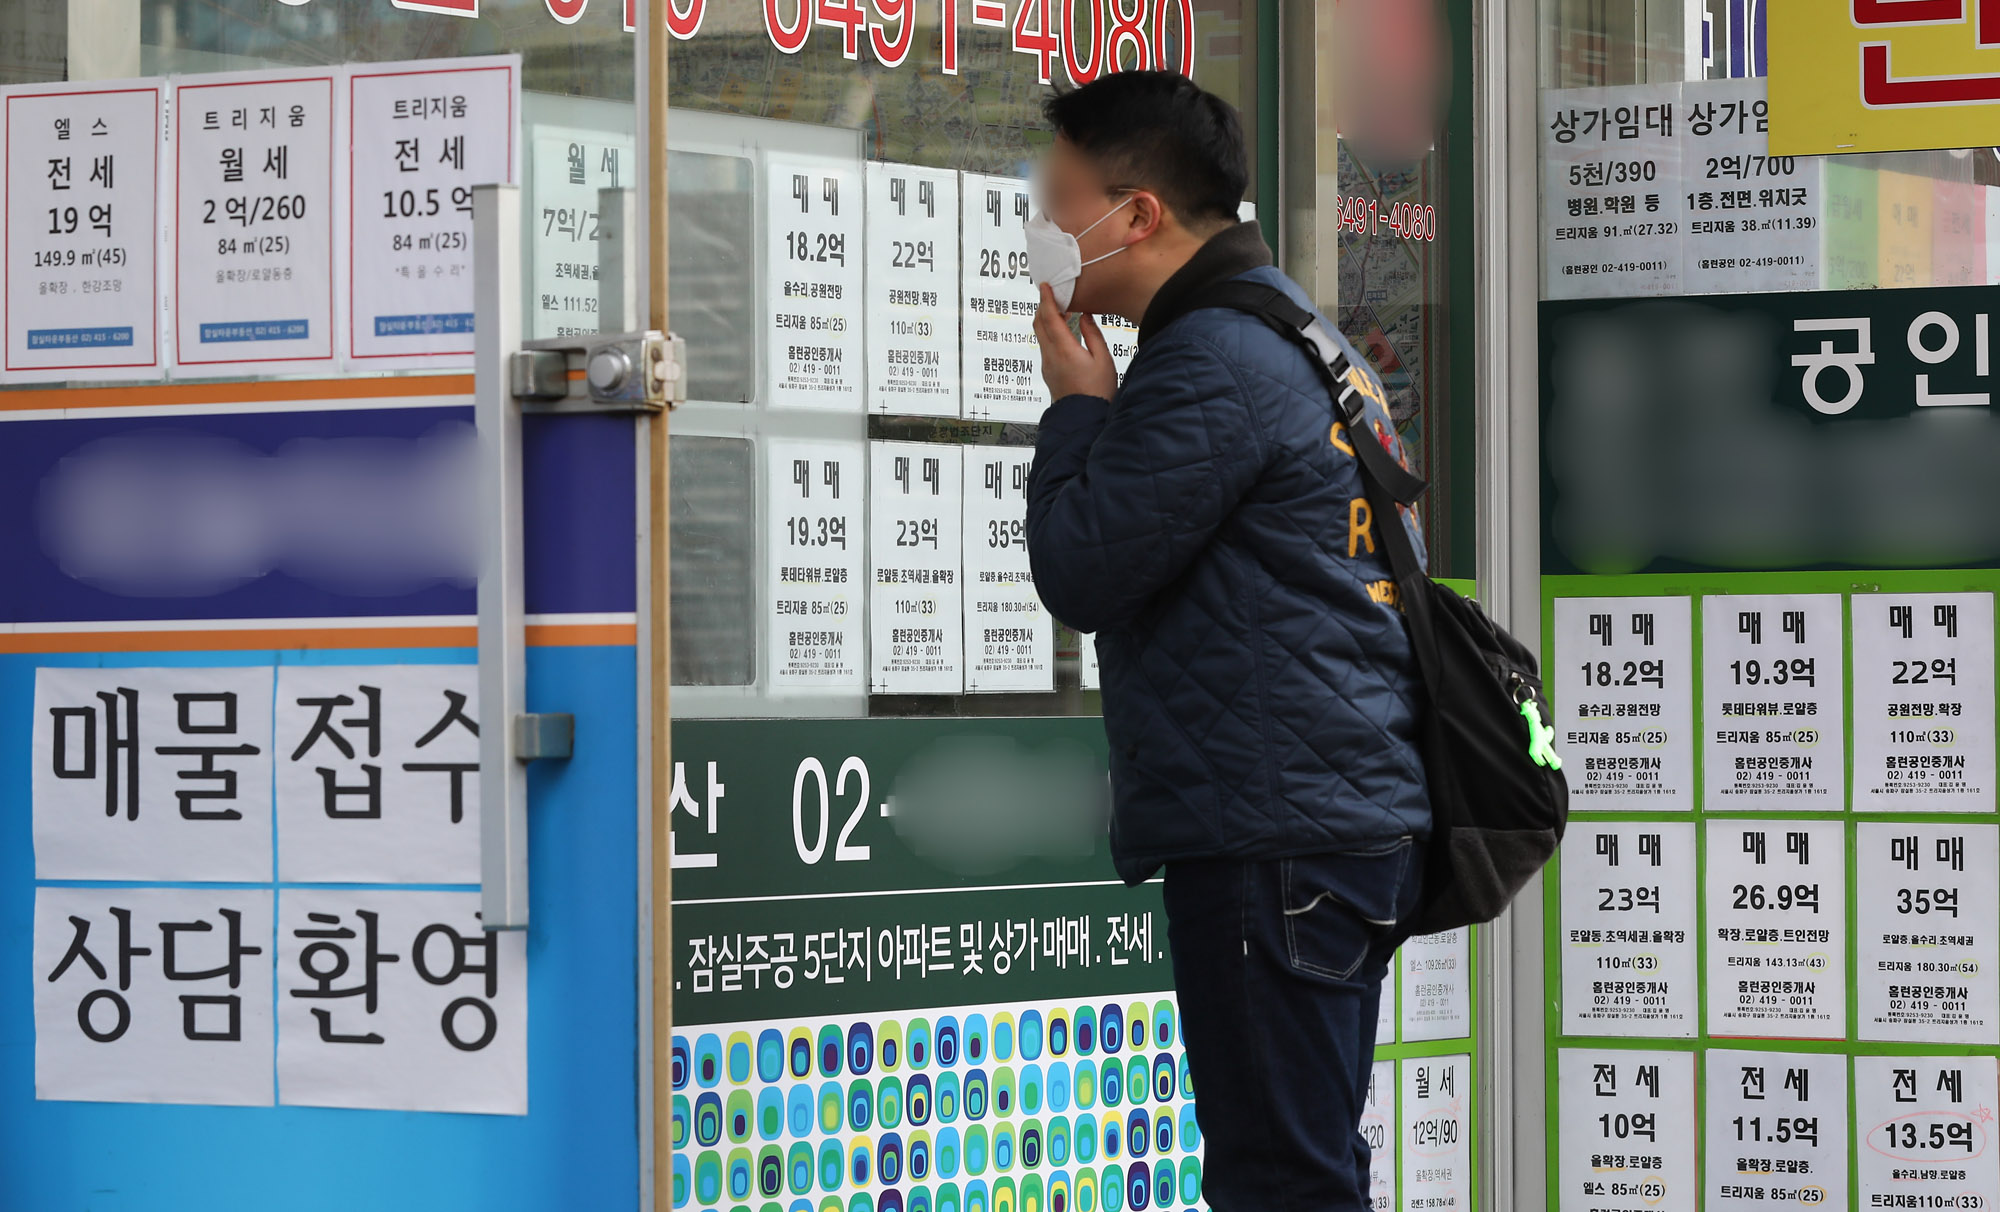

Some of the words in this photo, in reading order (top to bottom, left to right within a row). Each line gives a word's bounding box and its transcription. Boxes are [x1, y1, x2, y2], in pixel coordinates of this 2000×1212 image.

[393, 96, 467, 120] 트리지움
[1550, 103, 1672, 143] 상가임대
[1569, 161, 1655, 186] 5천/390
[1706, 155, 1797, 180] 2억/700
[203, 200, 215, 223] 2
[226, 195, 305, 227] 억/260
[384, 189, 439, 218] 10.5
[1568, 195, 1635, 216] 병원.학원
[1645, 194, 1659, 212] 등
[49, 207, 78, 234] 19
[89, 204, 111, 237] 억
[1692, 221, 1735, 233] 트리지움
[1556, 227, 1598, 240] 트리지움
[218, 239, 236, 255] 84
[393, 234, 412, 251] 84
[787, 231, 844, 267] 18.2억
[35, 250, 75, 267] 149.9
[893, 241, 933, 272] 22억
[1740, 256, 1804, 267] 02-419-0011)
[1602, 261, 1666, 272] 02-419-0011)
[784, 346, 847, 363] 홈런공인중개사
[885, 349, 943, 366] 홈런공인중개사
[984, 358, 1032, 373] 홈런공인중개사
[788, 516, 845, 550] 19.3억
[897, 518, 937, 550] 23억
[789, 632, 842, 646] 홈런공인중개사
[892, 629, 942, 642] 홈런공인중개사
[984, 629, 1033, 642] 홈런공인중개사
[1582, 660, 1663, 688] 18.2억
[1731, 658, 1814, 687] 19.3억
[1893, 658, 1955, 685] 22억
[1578, 704, 1661, 716] 올수리.공원전망
[1722, 703, 1817, 715] 롯데타워뷰.로얄층
[1888, 703, 1962, 716] 공원전망.확장
[1567, 732, 1609, 744] 트리지움
[1717, 731, 1760, 743] 트리지움
[49, 687, 260, 821] 매물
[1886, 756, 1965, 768] 홈런공인중개사
[1585, 757, 1661, 769] 홈런공인중개사
[1735, 757, 1812, 769] 홈런공인중개사
[1756, 772, 1773, 780] 419
[1787, 771, 1809, 780] 0011
[1599, 886, 1659, 913] 23억
[1733, 884, 1818, 913] 26.9억
[1897, 888, 1957, 918] 35억
[689, 933, 797, 992] 잠실주공
[804, 927, 870, 983] 5단지
[879, 924, 954, 979] 아파트
[961, 921, 983, 975] 및
[989, 918, 1038, 974] 상가
[1043, 915, 1089, 969] 매매
[1107, 912, 1151, 965] 전세
[1728, 957, 1760, 966] 트리지움
[1878, 962, 1912, 971] 트리지움
[48, 907, 262, 1043] 상담
[1593, 982, 1668, 994] 홈런공인중개사
[1738, 981, 1816, 995] 홈런공인중개사
[1889, 986, 1968, 999] 홈런공인중개사
[1413, 1119, 1457, 1147] 12억/90
[1599, 1113, 1655, 1142] 10억
[1733, 1117, 1817, 1147] 11.5억
[1886, 1123, 1972, 1152] 13.5억
[1583, 1182, 1605, 1195] 엘스
[1721, 1186, 1765, 1199] 트리지움
